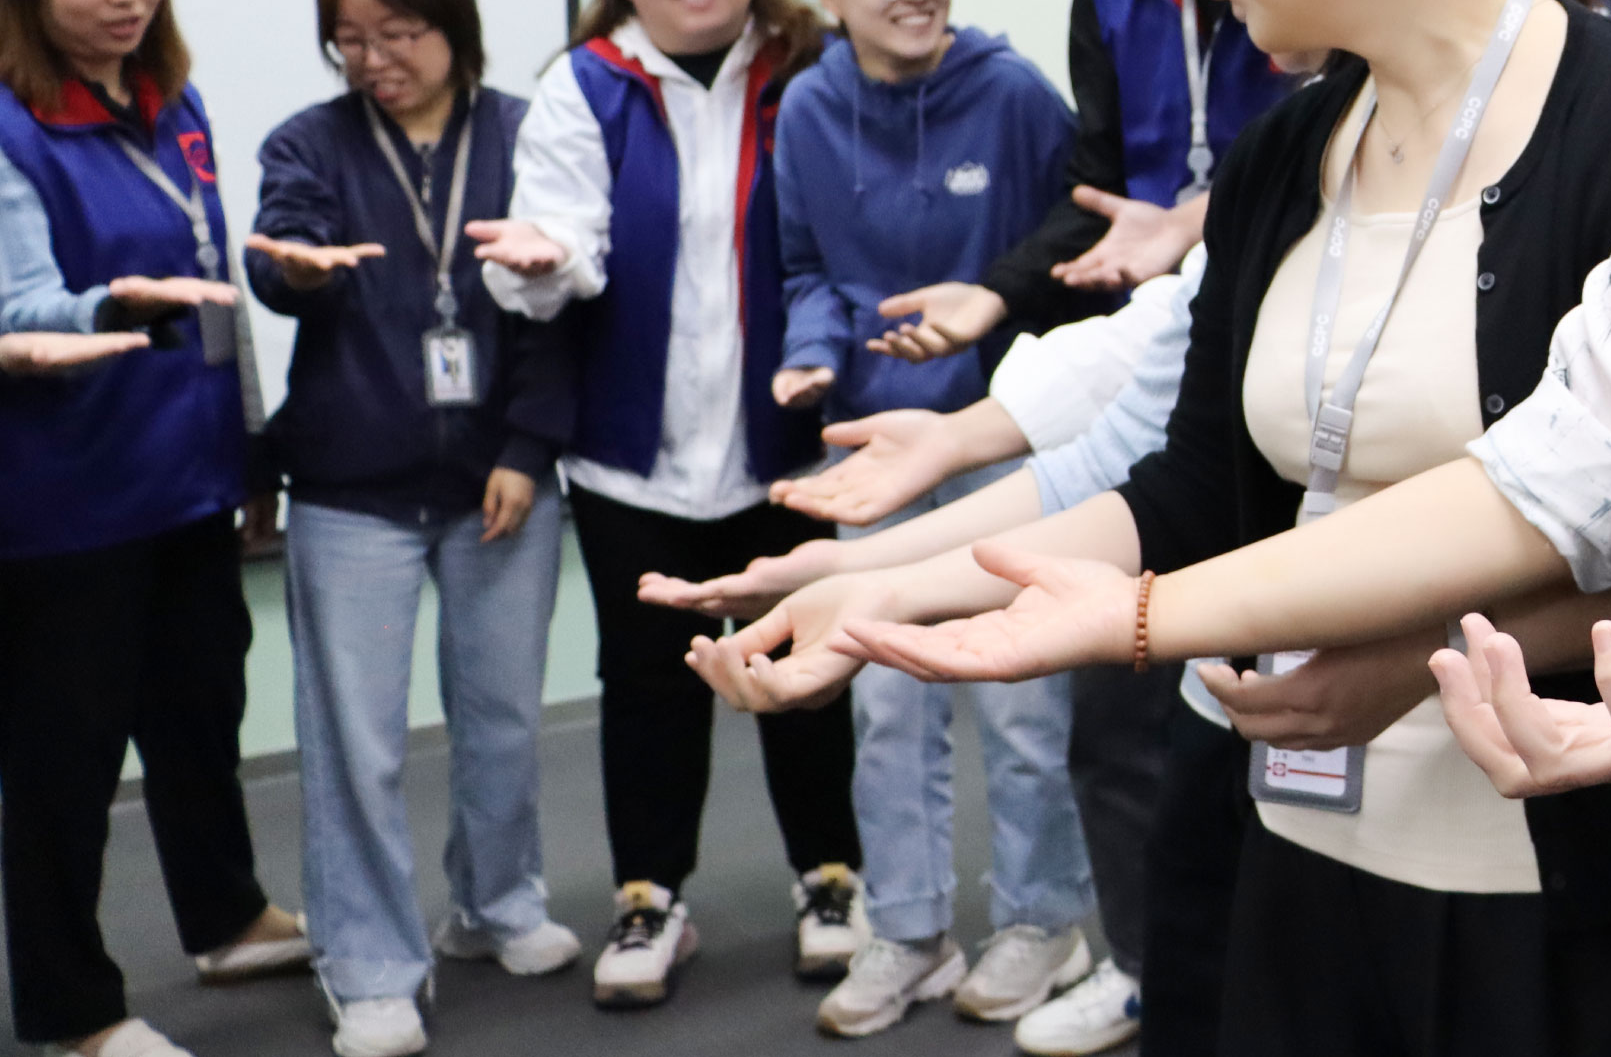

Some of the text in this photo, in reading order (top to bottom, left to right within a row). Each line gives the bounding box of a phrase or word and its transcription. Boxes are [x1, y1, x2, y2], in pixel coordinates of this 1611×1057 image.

[1498, 2, 1524, 42] CCPC
[1455, 96, 1482, 140] CCPC
[1329, 216, 1347, 257] CCPC
[1416, 198, 1439, 240] CCPC
[1312, 314, 1330, 357] CCPC
